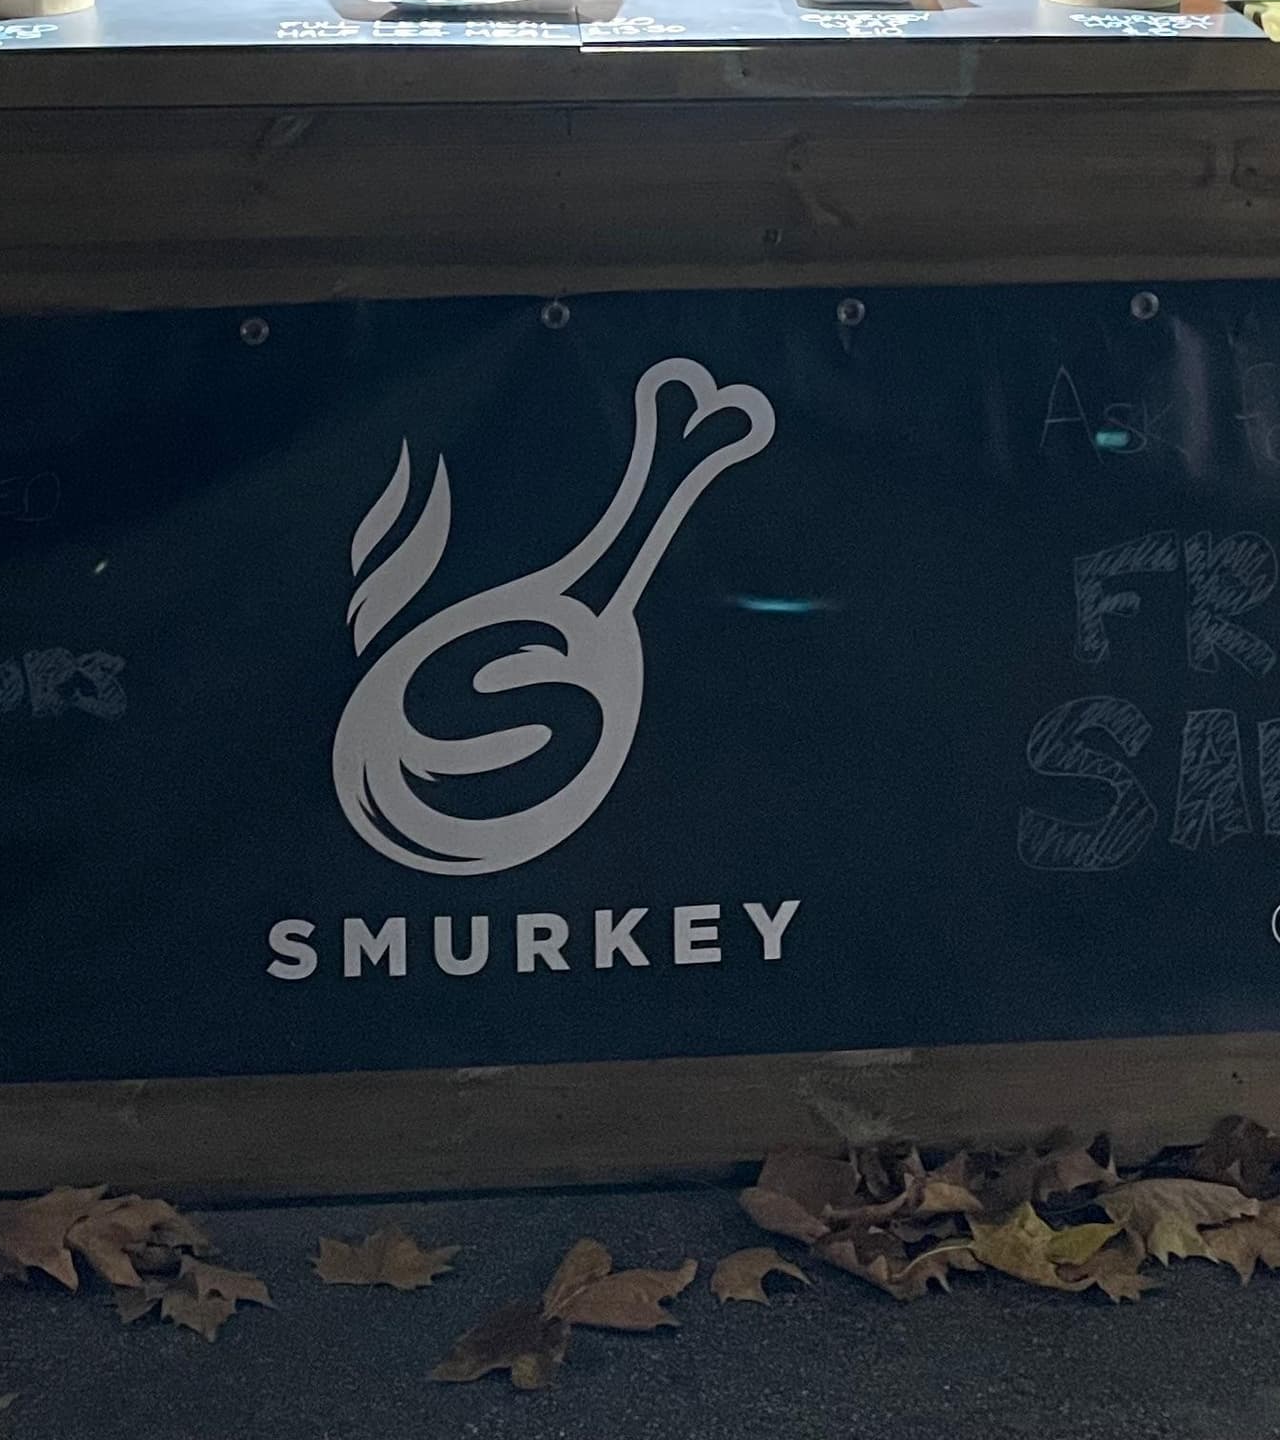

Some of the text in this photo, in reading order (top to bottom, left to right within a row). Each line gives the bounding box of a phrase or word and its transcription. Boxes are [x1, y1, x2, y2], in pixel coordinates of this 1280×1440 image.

[279, 20, 361, 30] FULL
[276, 28, 360, 39] HALF
[464, 29, 572, 40] MEAL
[266, 899, 801, 981] SMURKEY
